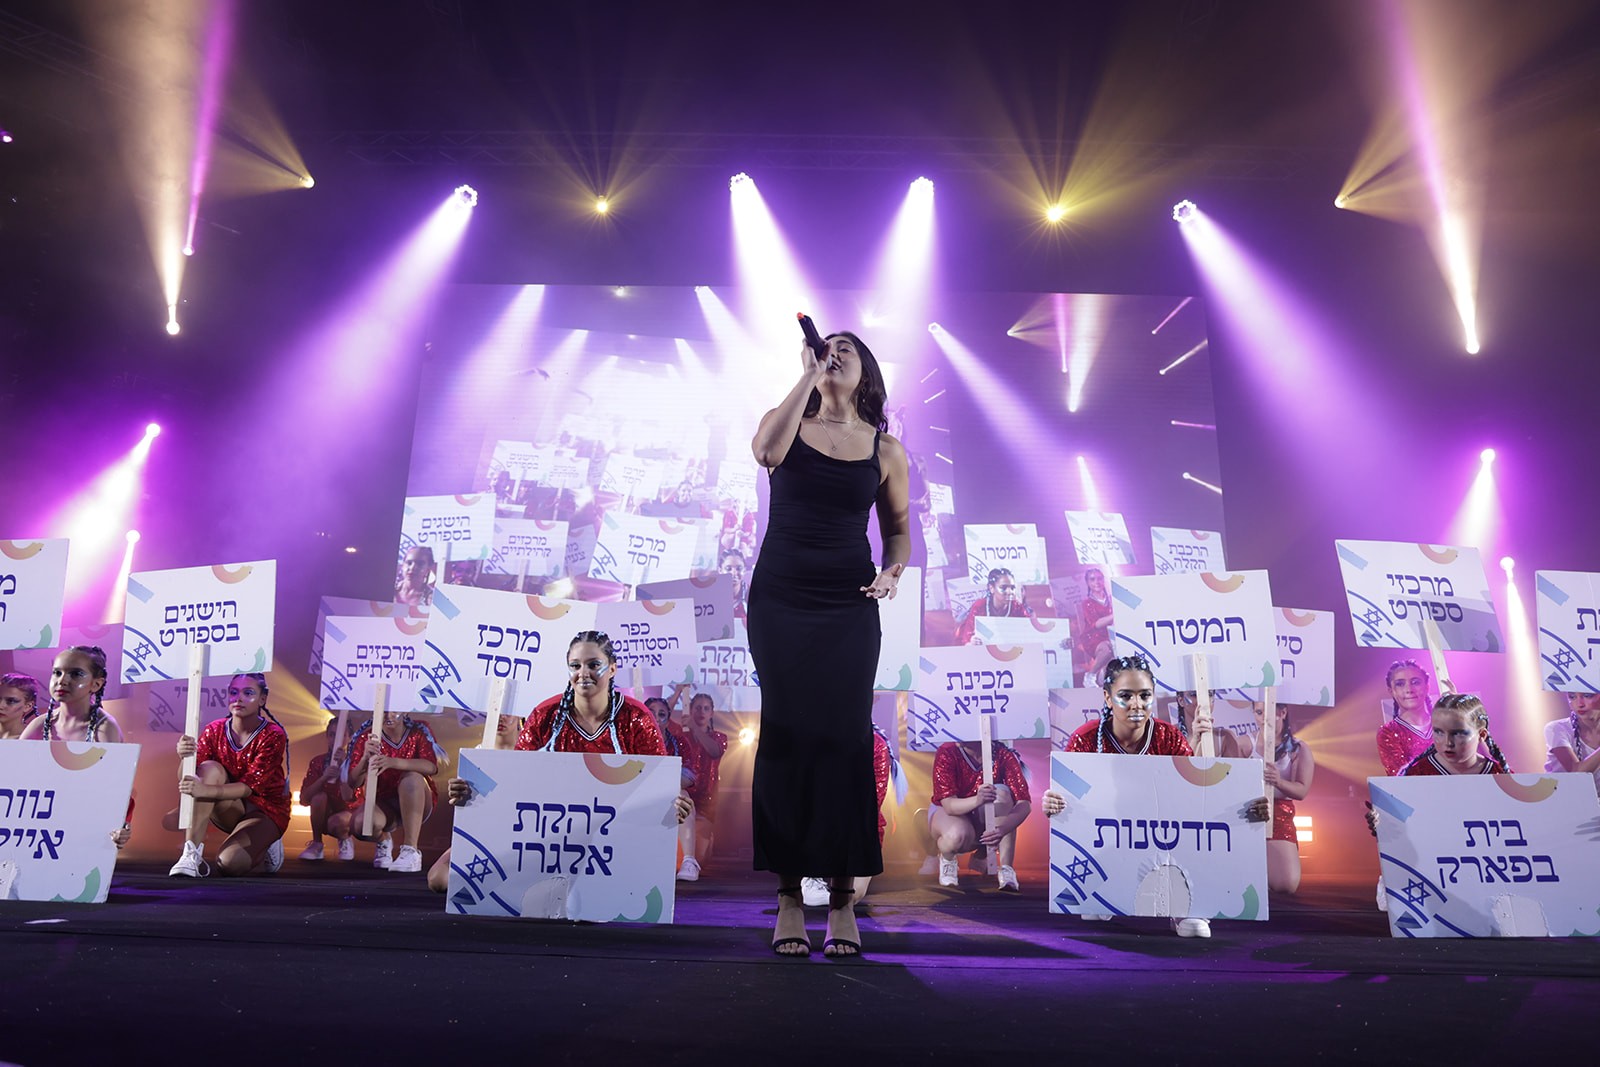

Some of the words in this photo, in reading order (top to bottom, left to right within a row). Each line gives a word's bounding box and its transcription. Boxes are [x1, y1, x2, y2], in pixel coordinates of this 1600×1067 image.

[421, 515, 471, 530] הישגים
[417, 528, 472, 544] בספורט
[508, 535, 547, 546] מרכזים
[628, 533, 666, 553] מרכז
[1089, 540, 1120, 551] ספורט
[501, 545, 552, 558] קהילתיים
[627, 551, 660, 569] חסד
[981, 545, 1028, 560] המטרו
[1169, 544, 1208, 558] הרכבת
[1173, 556, 1207, 572] הקלה
[1386, 574, 1454, 598] מרכזי
[164, 599, 237, 624] הישגים
[1388, 598, 1464, 624] ספורט
[159, 623, 240, 647] בספורט
[477, 623, 540, 653] מרכז
[620, 622, 650, 636] כפר
[1146, 616, 1247, 646] המטרו
[356, 644, 415, 661] מרכזים
[477, 653, 532, 681] חסד
[946, 670, 1014, 691] מכינת
[954, 690, 1009, 716] לביא
[512, 796, 617, 838] להקת
[1093, 818, 1231, 852] חדשנות
[1463, 819, 1528, 848] בית
[512, 836, 613, 876] אלגרו
[1436, 854, 1560, 889] בפארק
